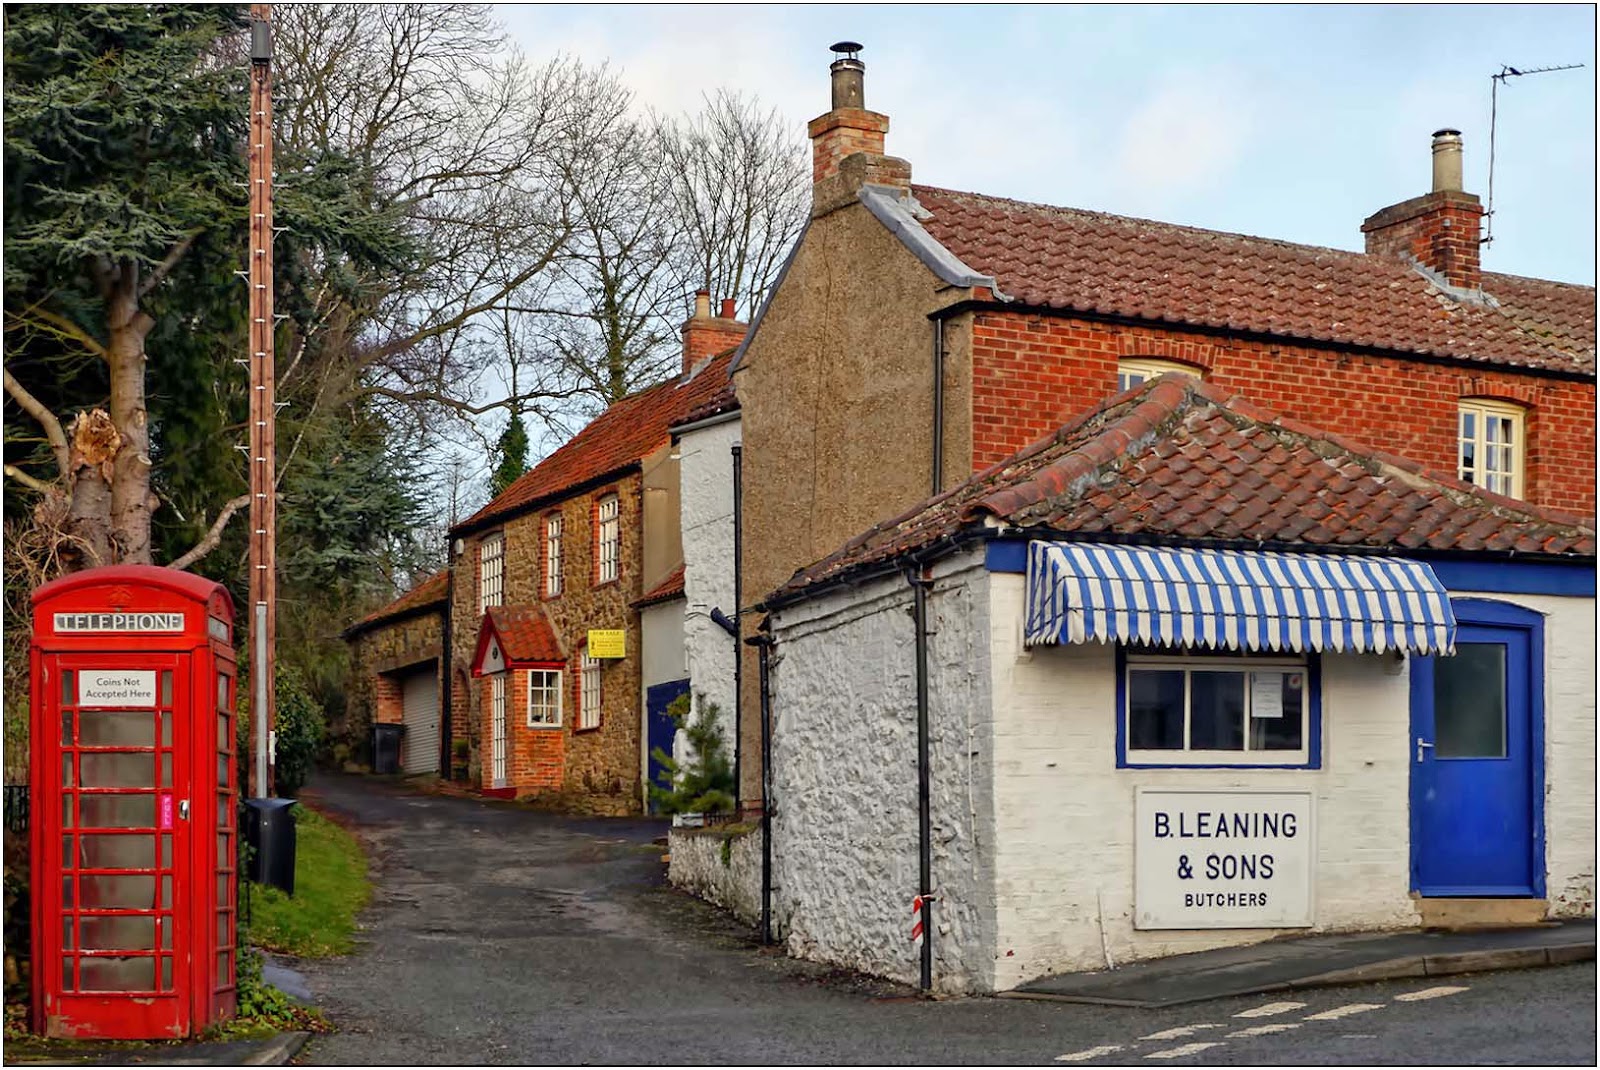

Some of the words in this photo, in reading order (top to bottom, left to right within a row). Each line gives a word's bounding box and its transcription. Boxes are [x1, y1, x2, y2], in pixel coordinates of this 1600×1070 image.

[60, 614, 182, 629] TELEPHONE
[96, 677, 121, 686] Coins
[123, 678, 141, 686] Not
[85, 689, 127, 700] Accepted
[129, 689, 152, 698] Here
[1177, 854, 1194, 880] &
[1206, 854, 1274, 880] SONS
[1185, 892, 1268, 907] BUTCHERS
